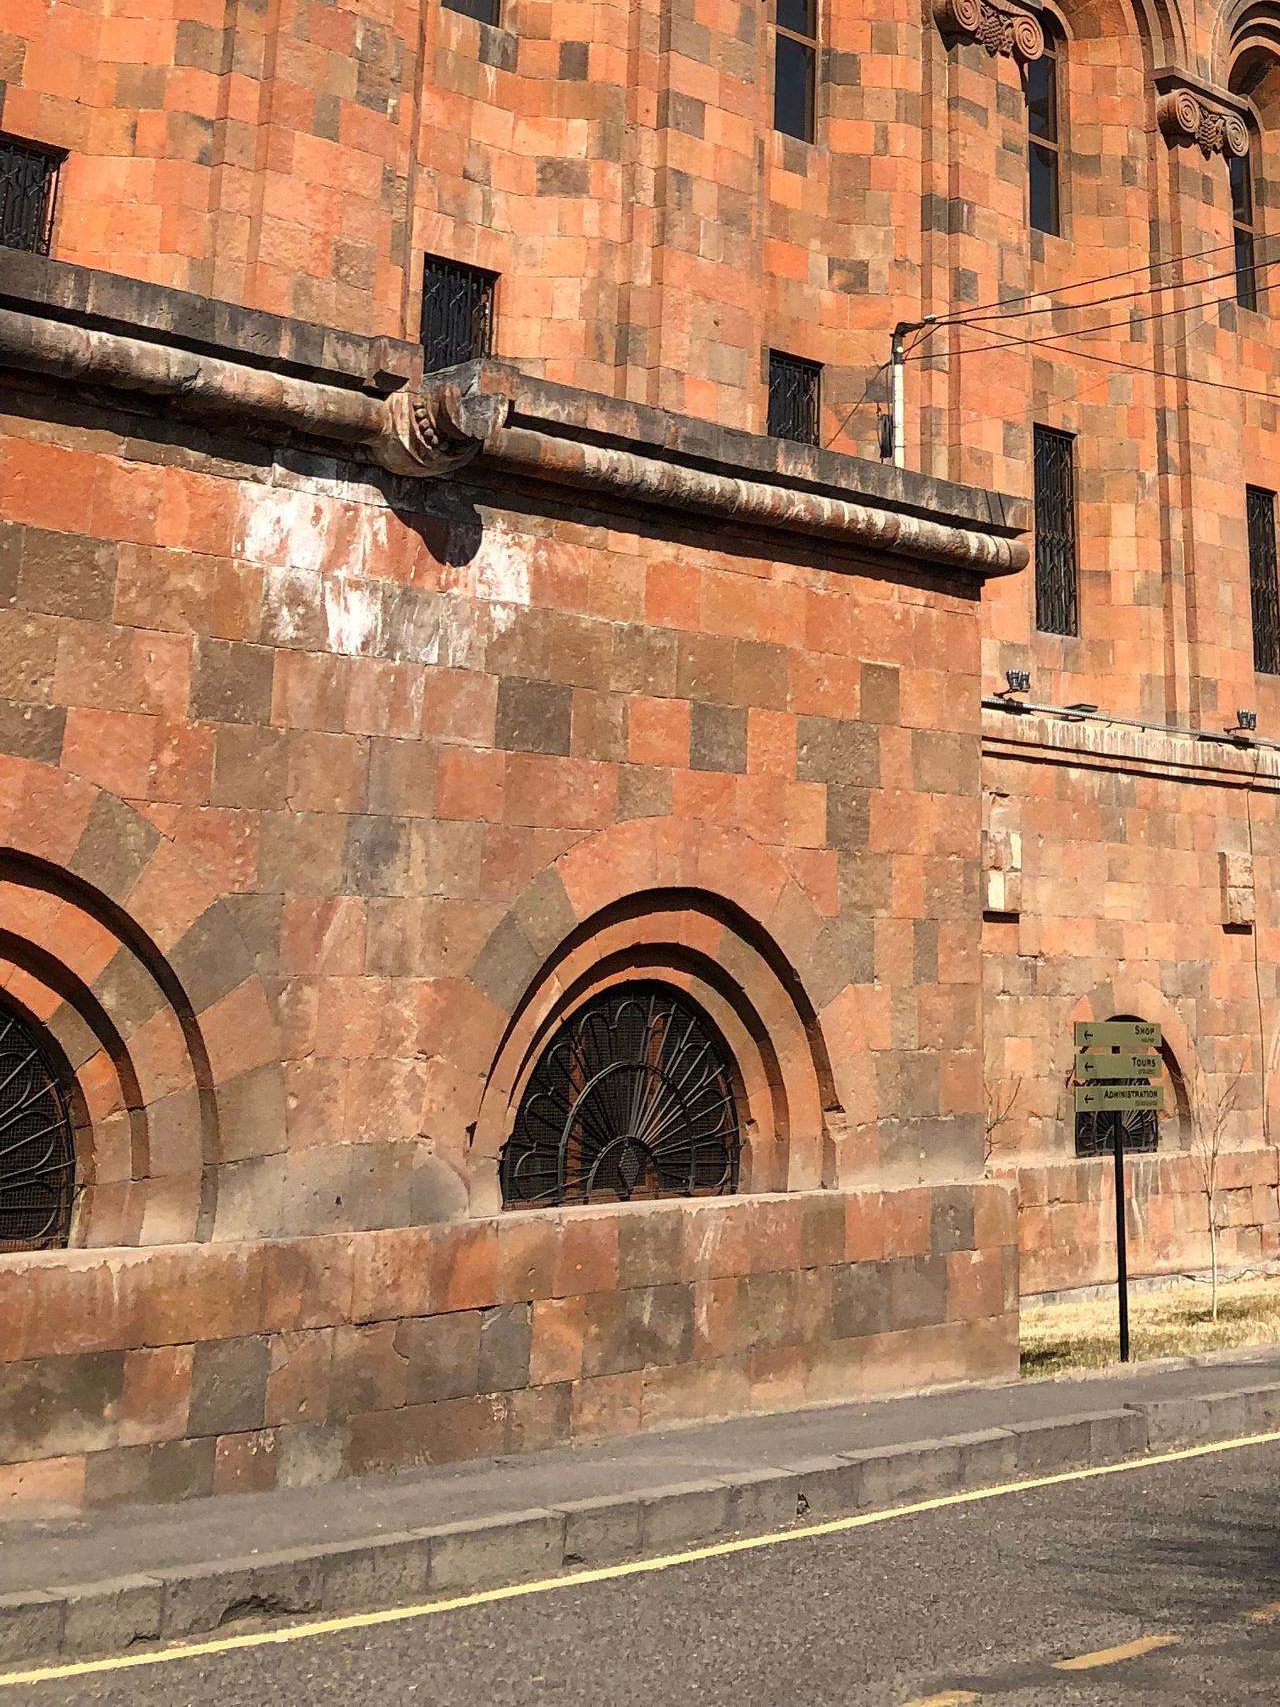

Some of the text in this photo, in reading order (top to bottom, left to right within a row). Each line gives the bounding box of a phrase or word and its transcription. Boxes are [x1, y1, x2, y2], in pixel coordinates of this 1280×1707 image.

[1134, 1025, 1155, 1035] SHOP
[1131, 1057, 1156, 1067] TOURS
[1103, 1090, 1158, 1099] ADMINISTRATION
